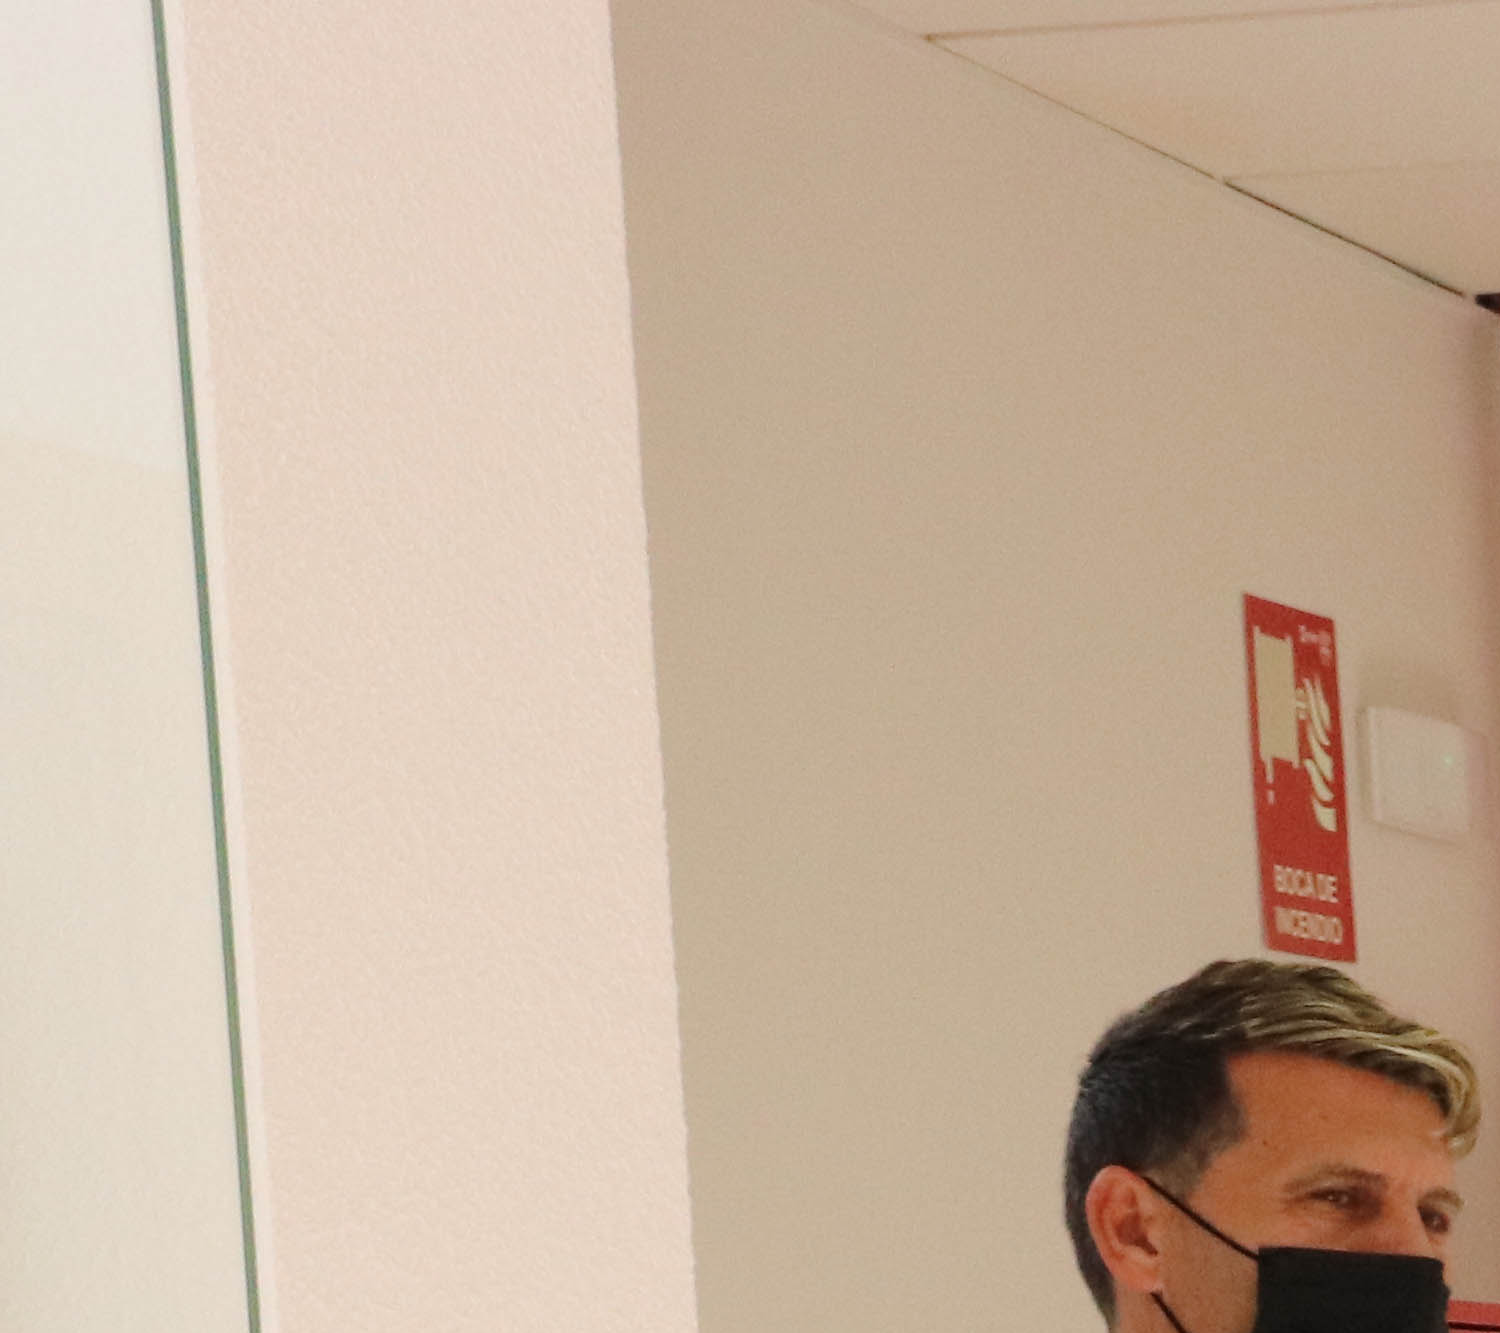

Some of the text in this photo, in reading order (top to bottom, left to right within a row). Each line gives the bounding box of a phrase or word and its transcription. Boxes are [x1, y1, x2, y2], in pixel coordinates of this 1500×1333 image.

[1273, 864, 1339, 903] BOCA DE
[1274, 906, 1344, 944] INCENDIO
